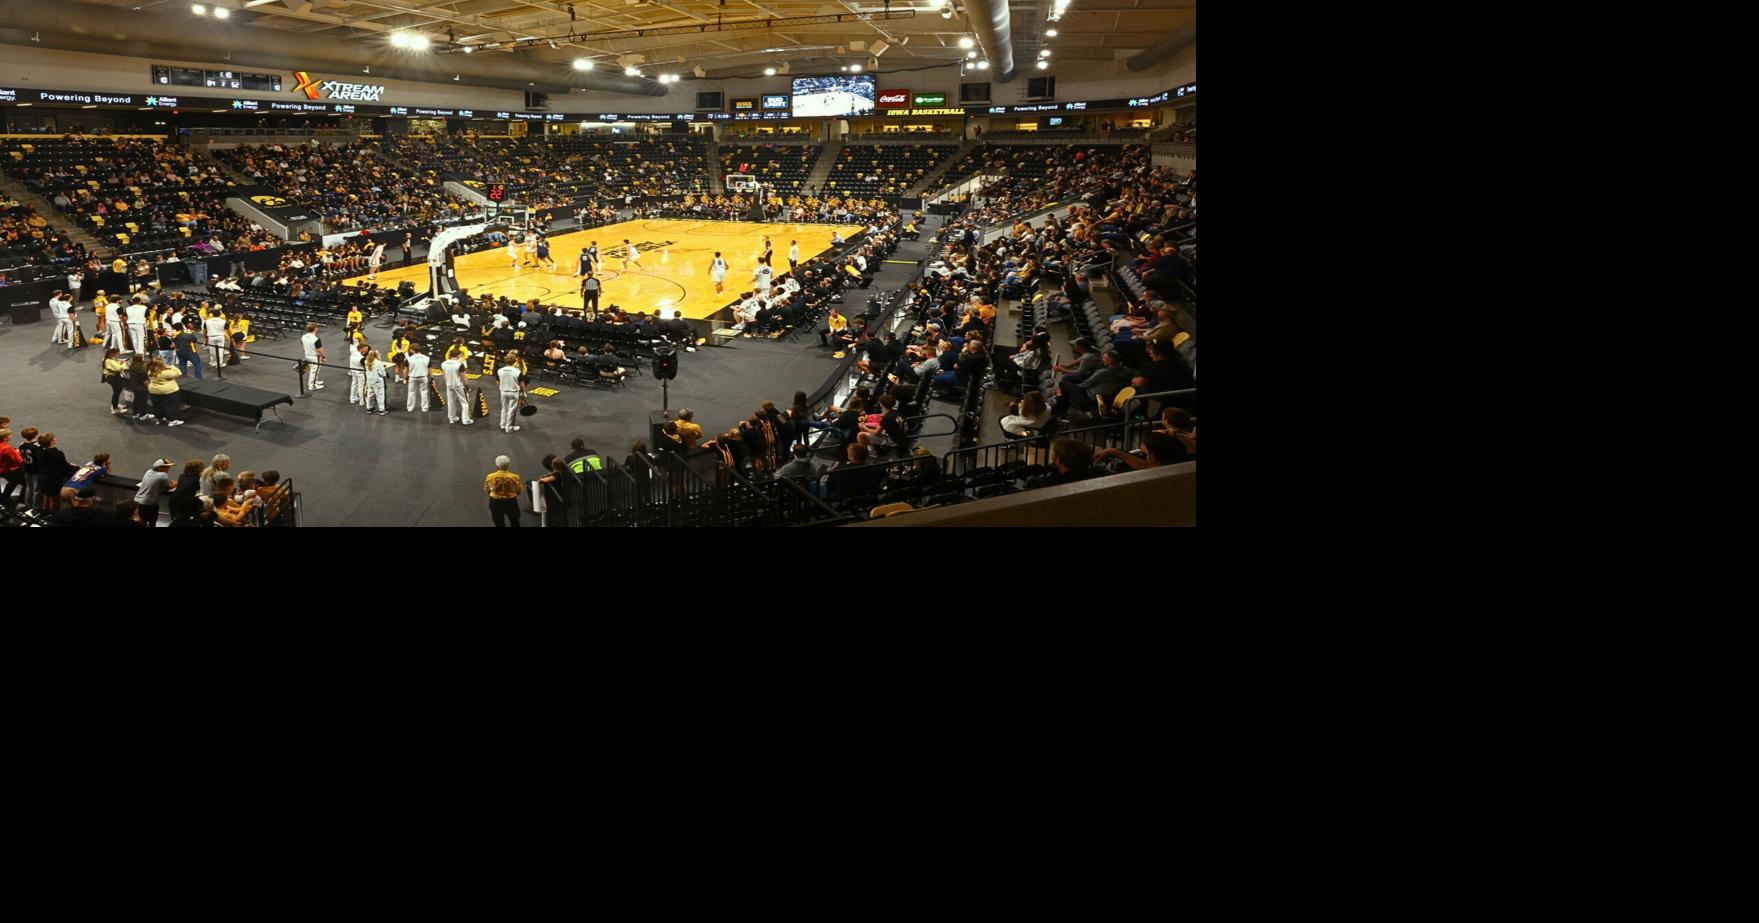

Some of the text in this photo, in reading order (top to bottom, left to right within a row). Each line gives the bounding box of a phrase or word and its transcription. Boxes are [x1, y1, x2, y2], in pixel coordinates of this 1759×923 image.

[321, 80, 384, 94] XTREAM
[40, 92, 131, 104] Powering Beyond
[328, 91, 380, 101] ARENA
[271, 102, 301, 110] Powering
[912, 108, 966, 116] BASKETBALL
[490, 190, 502, 199] 22
[483, 353, 496, 376] LET'S
[479, 392, 489, 417] IOWA
